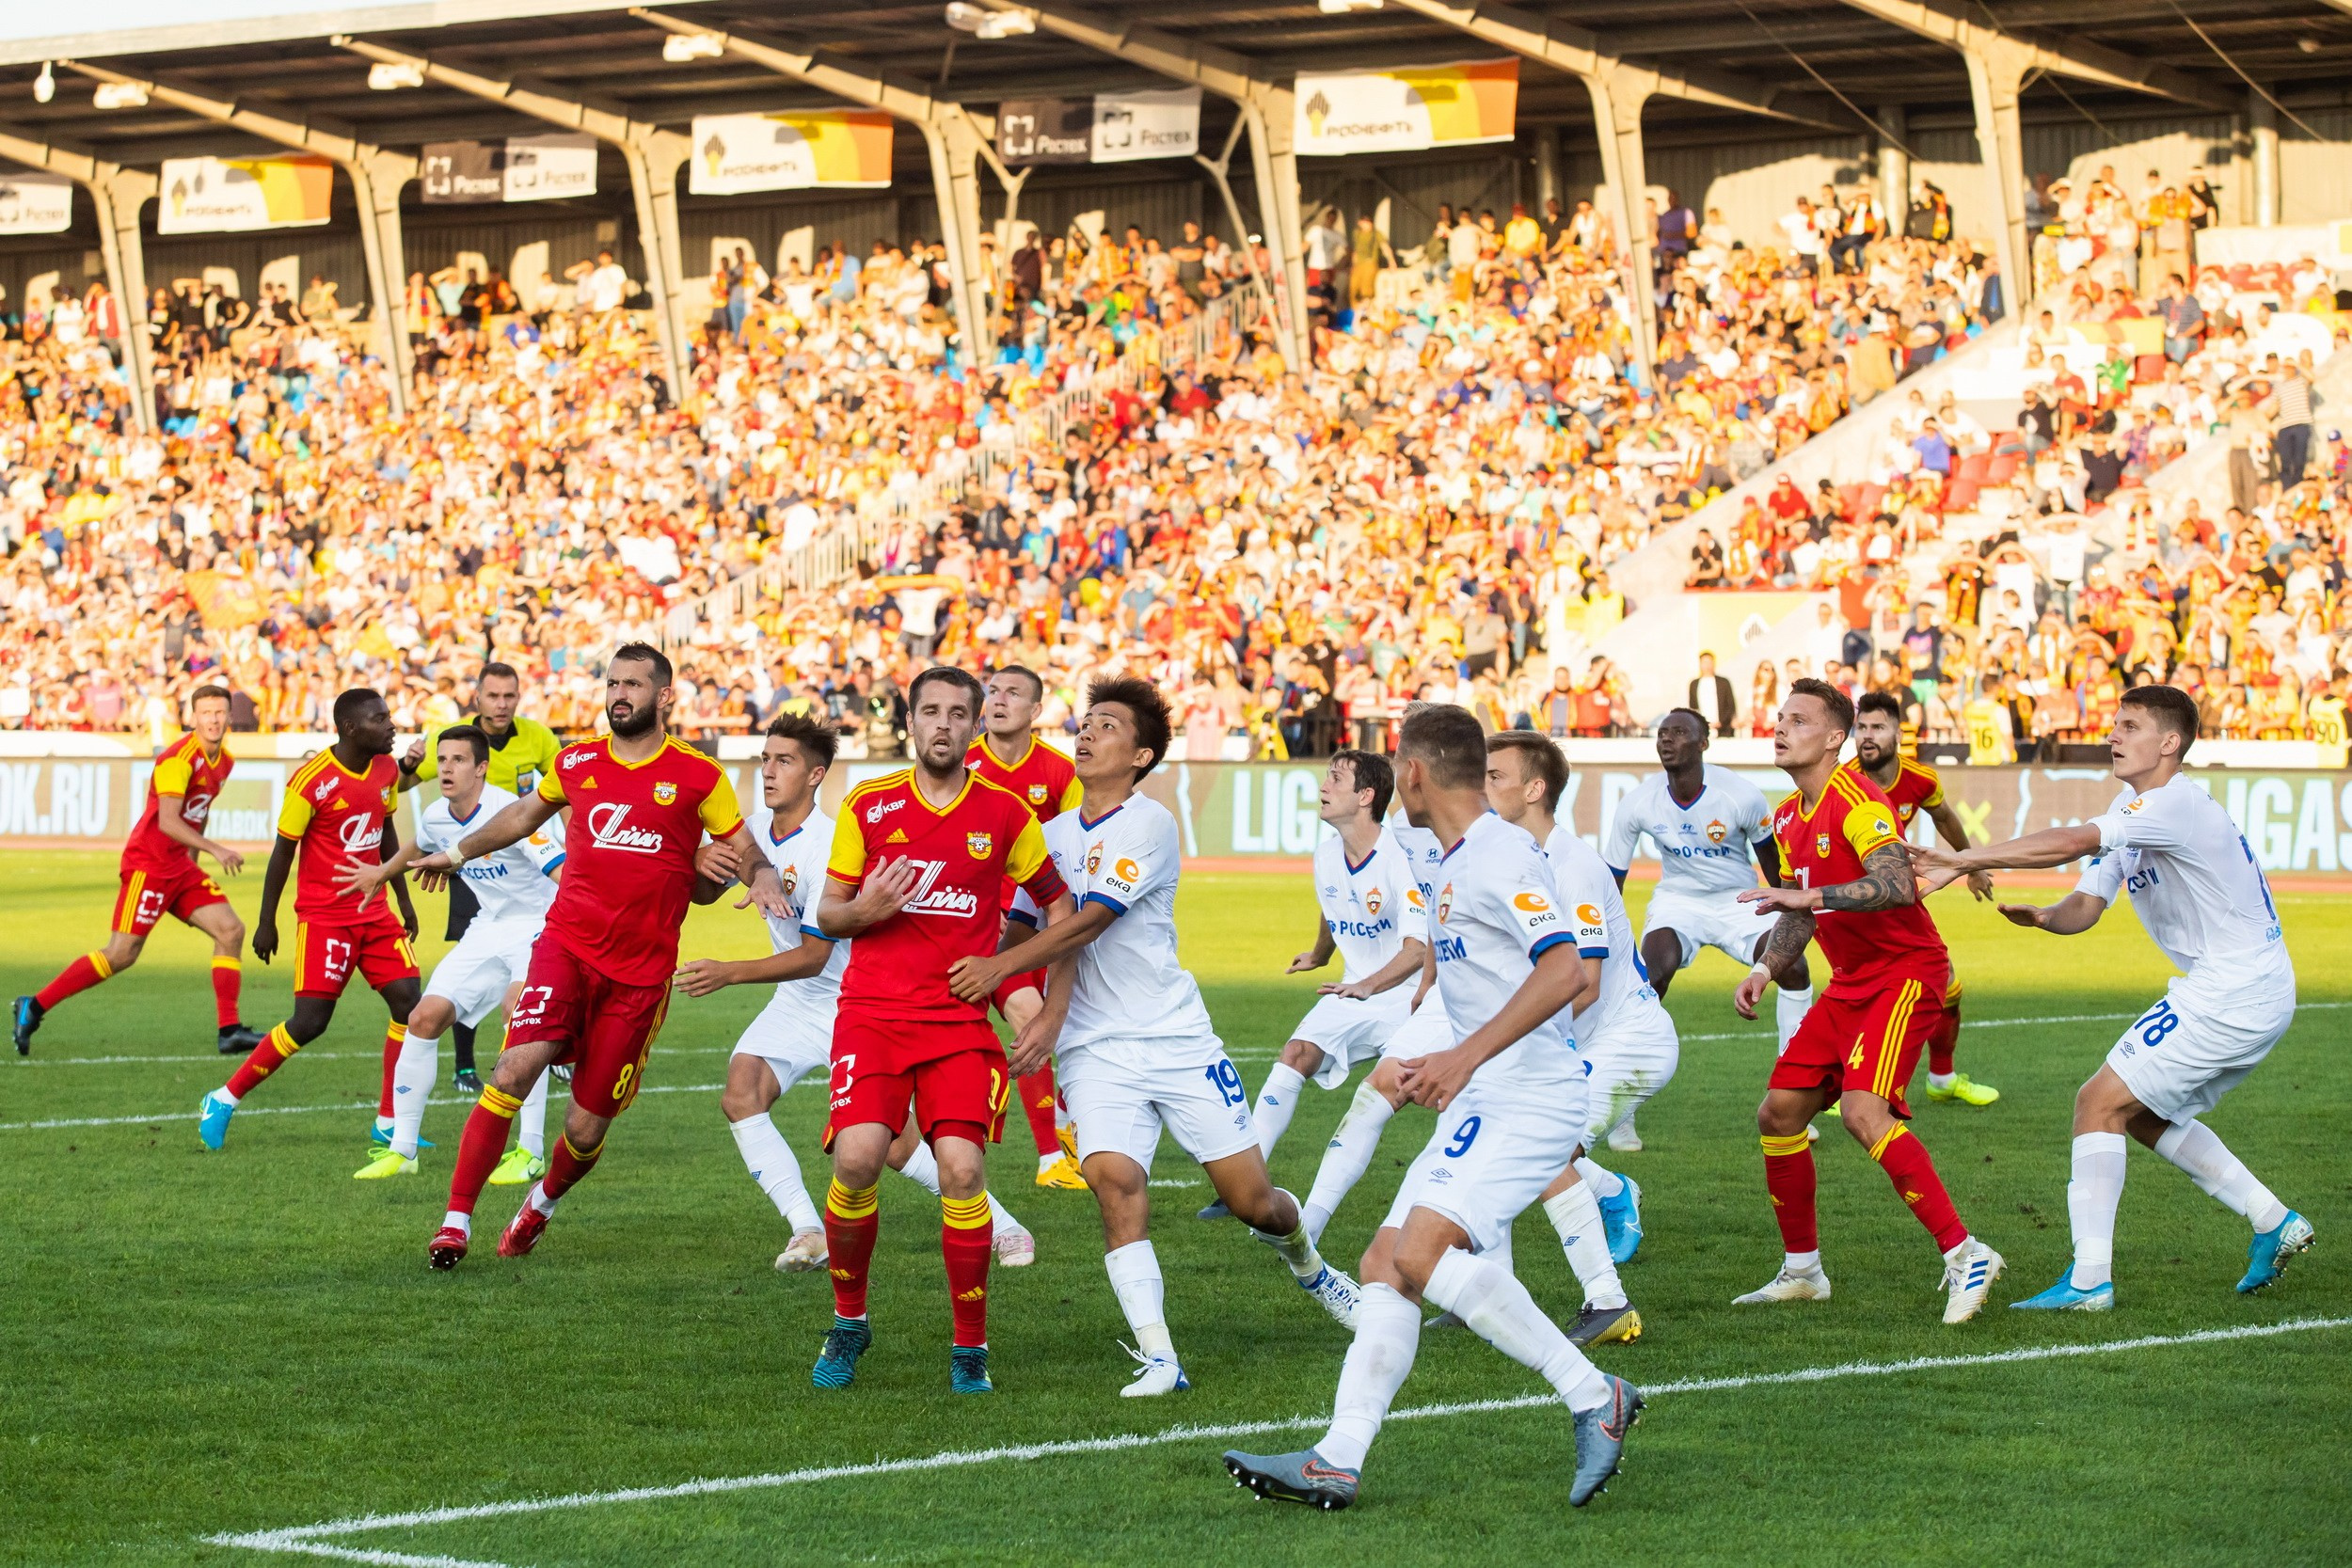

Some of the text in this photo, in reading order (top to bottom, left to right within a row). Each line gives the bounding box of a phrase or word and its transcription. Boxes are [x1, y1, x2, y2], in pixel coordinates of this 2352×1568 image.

[1232, 768, 1325, 855] LIG
[2191, 776, 2352, 872] IGA
[2134, 1000, 2179, 1047] 78
[1847, 1032, 1865, 1069] 4
[612, 1063, 634, 1100] 8
[830, 1095, 852, 1112] стех
[1204, 1058, 1245, 1108] 19
[1444, 1116, 1482, 1158] 9
